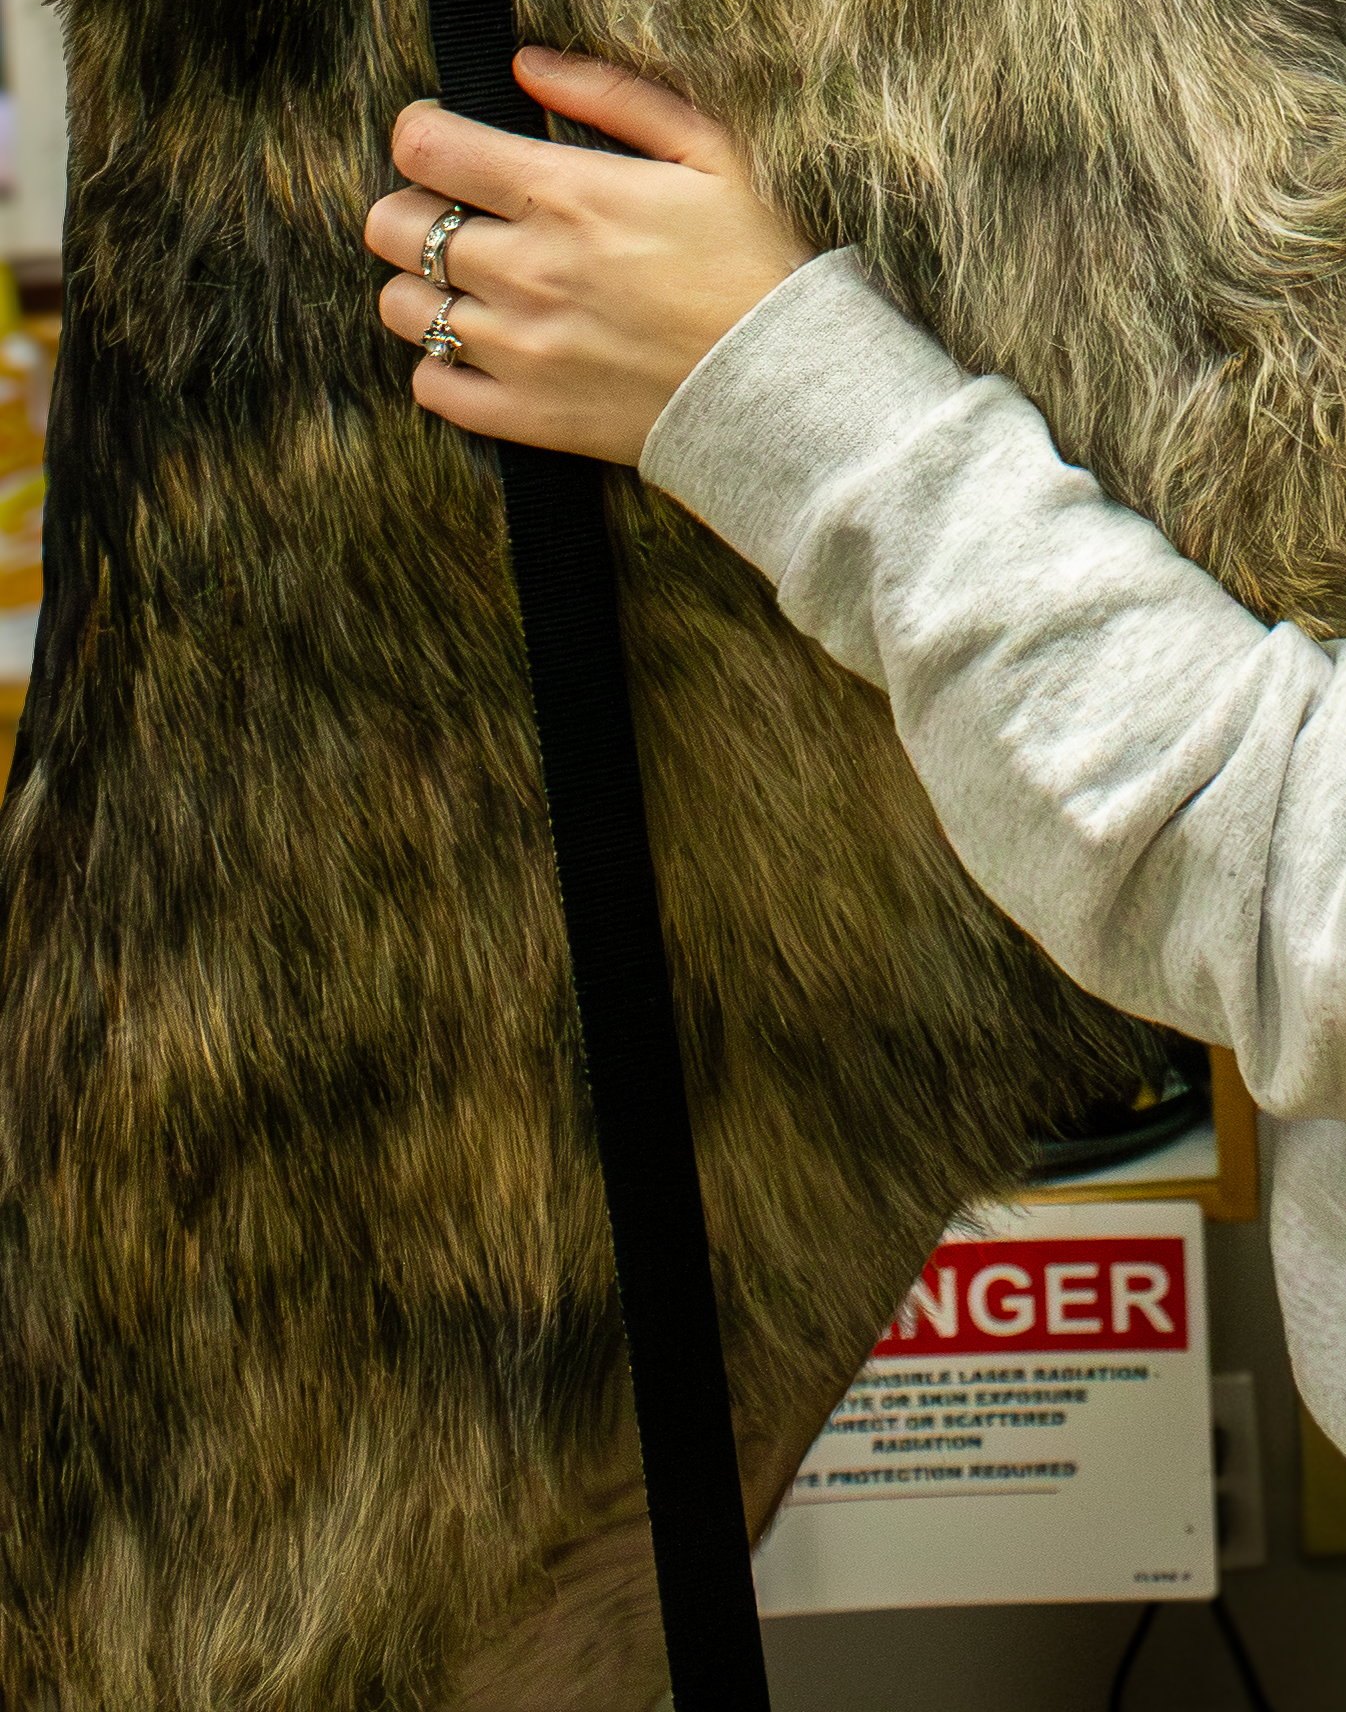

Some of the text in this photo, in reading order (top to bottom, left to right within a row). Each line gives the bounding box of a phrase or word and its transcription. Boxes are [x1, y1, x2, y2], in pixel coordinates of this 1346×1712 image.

[884, 1261, 1175, 1340] NGER
[957, 1368, 1026, 1385] LASER
[1032, 1367, 1149, 1383] RADIATION
[880, 1394, 910, 1409] OR
[918, 1392, 967, 1408] SKIN
[974, 1389, 1088, 1406] EXPOSURE
[905, 1416, 934, 1430] OR
[942, 1412, 1066, 1429] SCATTERED
[872, 1437, 982, 1454] RADIATION
[826, 1465, 962, 1486] PROTECTION
[968, 1461, 1078, 1480] REQUIRED
